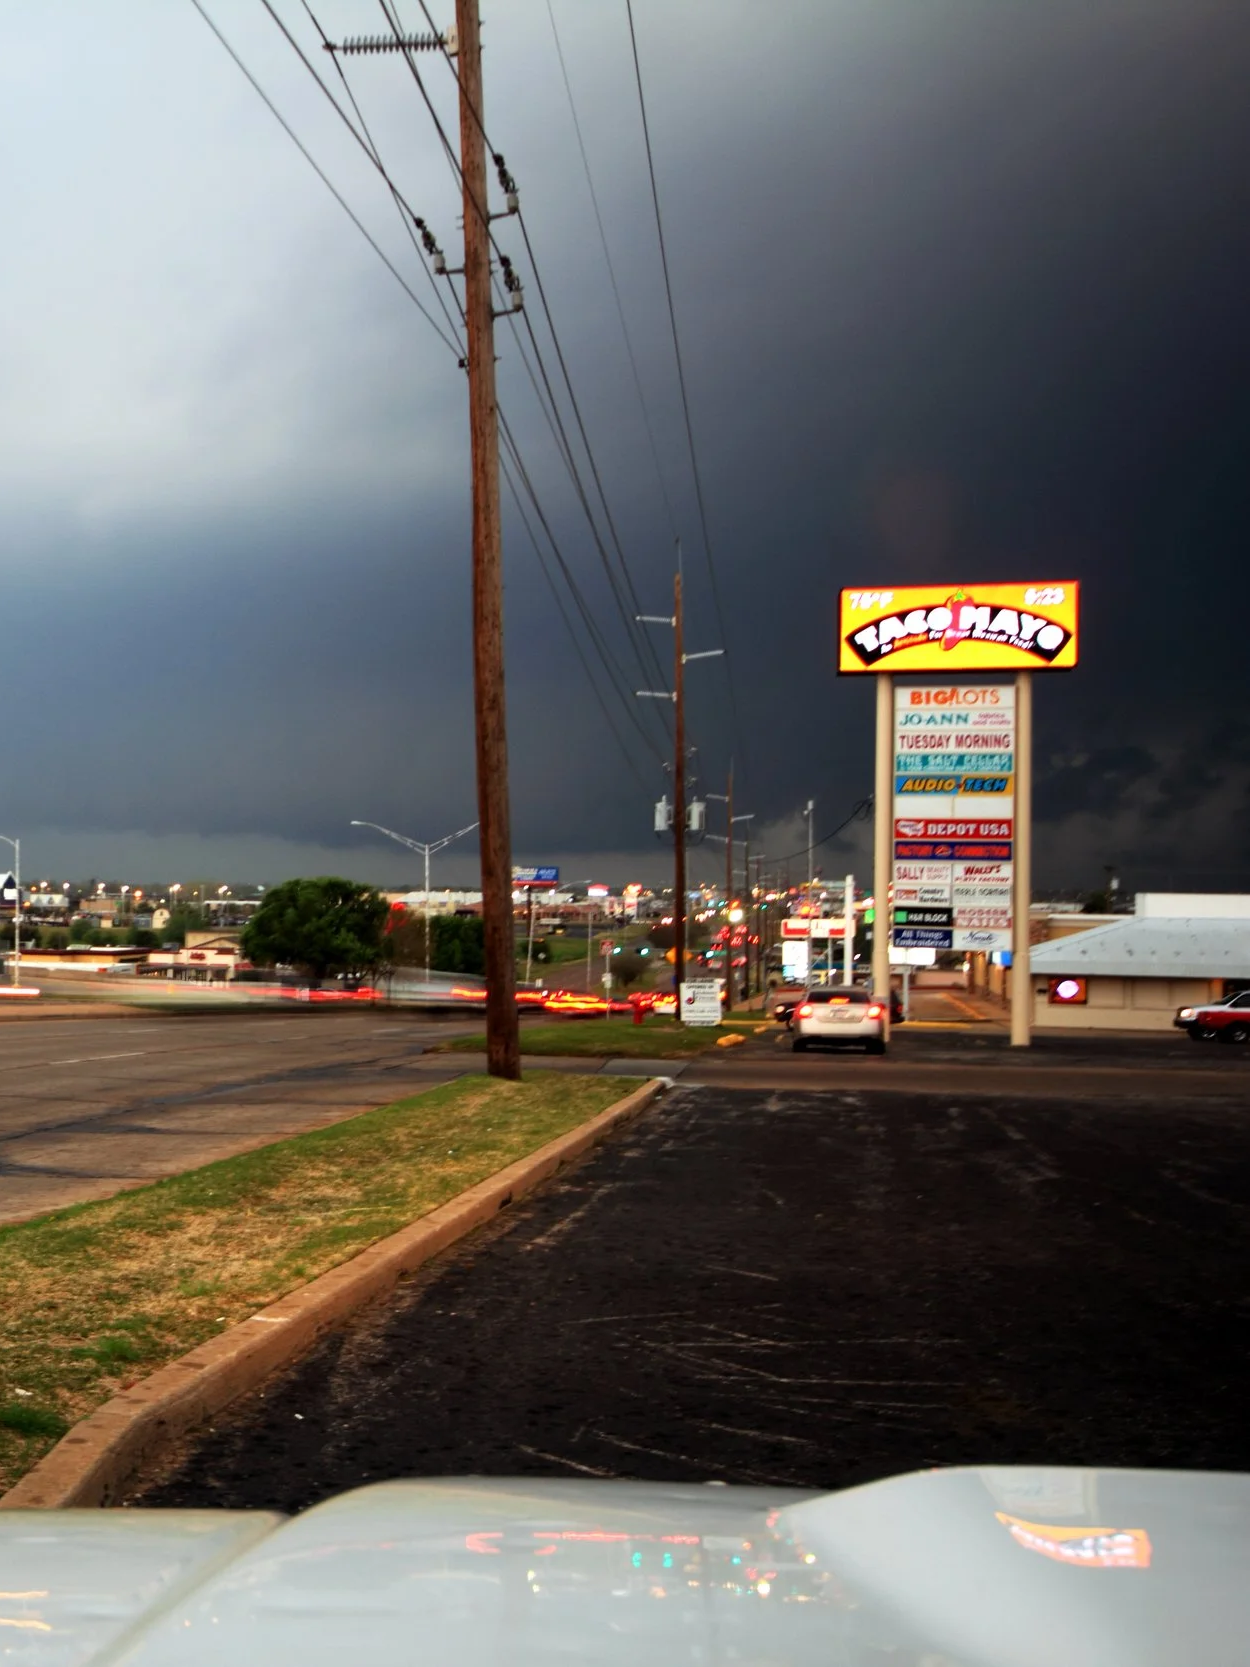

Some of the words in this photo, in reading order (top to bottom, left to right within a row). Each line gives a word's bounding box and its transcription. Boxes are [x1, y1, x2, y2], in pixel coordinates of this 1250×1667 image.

[854, 606, 953, 652] TACO
[958, 606, 1064, 651] MAYO
[956, 689, 1000, 705] LOTS
[899, 735, 951, 749] TUESDAY
[955, 734, 1011, 749] MORNING
[927, 823, 977, 836] DEPOT
[979, 823, 1010, 836] USA
[896, 865, 925, 881] SALLY
[908, 913, 924, 923] H&R
[924, 912, 948, 923] BLOCK
[916, 929, 944, 940] Things
